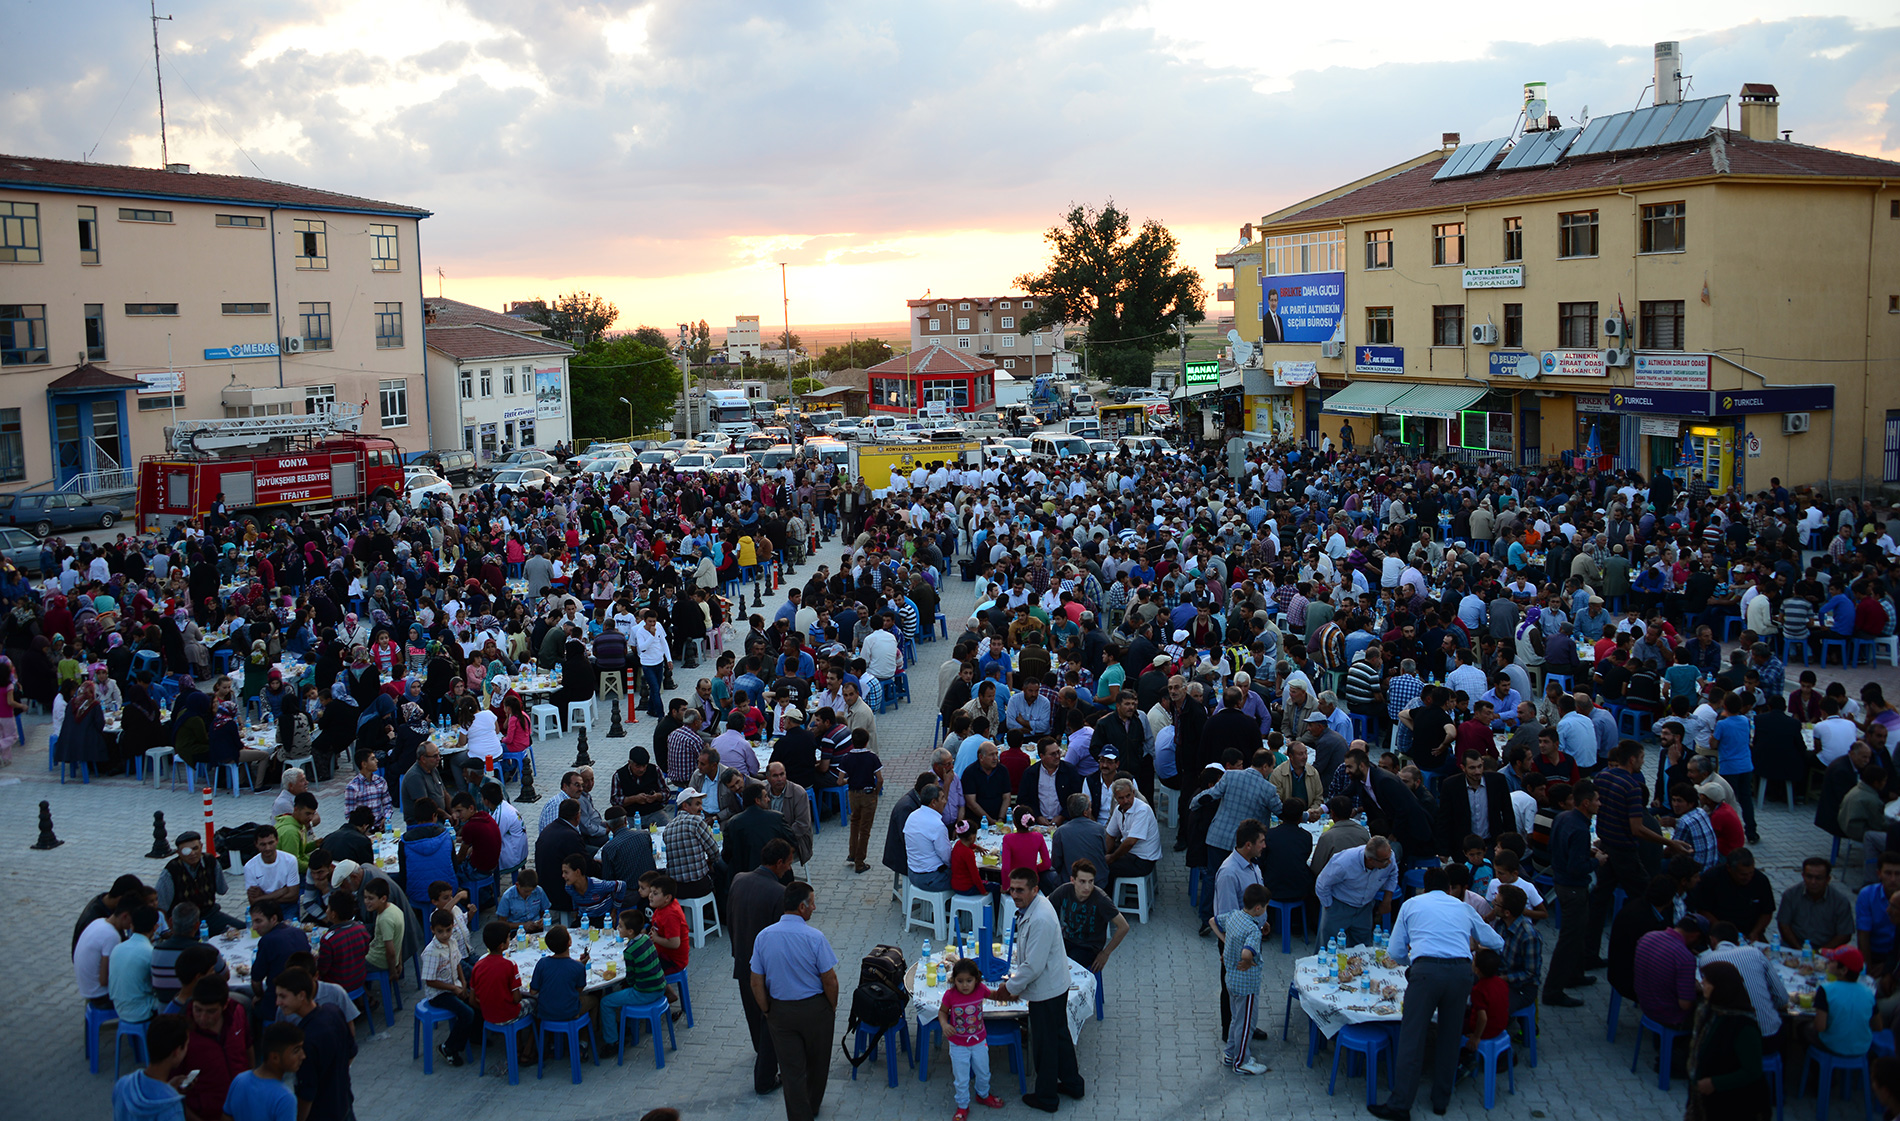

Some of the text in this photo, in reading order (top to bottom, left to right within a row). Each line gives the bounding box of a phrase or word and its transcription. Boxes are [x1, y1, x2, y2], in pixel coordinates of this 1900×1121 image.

[1302, 286, 1318, 296] DAHA
[1280, 302, 1340, 314] AK PARTİ ALTINEKİN
[1288, 316, 1333, 329] SEÇİM BÜROSU
[1499, 354, 1521, 364] BELEDİ
[1187, 366, 1217, 374] MANAV
[1624, 397, 1653, 405] TURKCELL
[1734, 398, 1764, 406] TURKCELL
[279, 458, 308, 468] KONYA
[257, 472, 330, 487] BÜYÜKŞEHİR BELEDİYESİ
[280, 490, 310, 501] İTFAİYE
